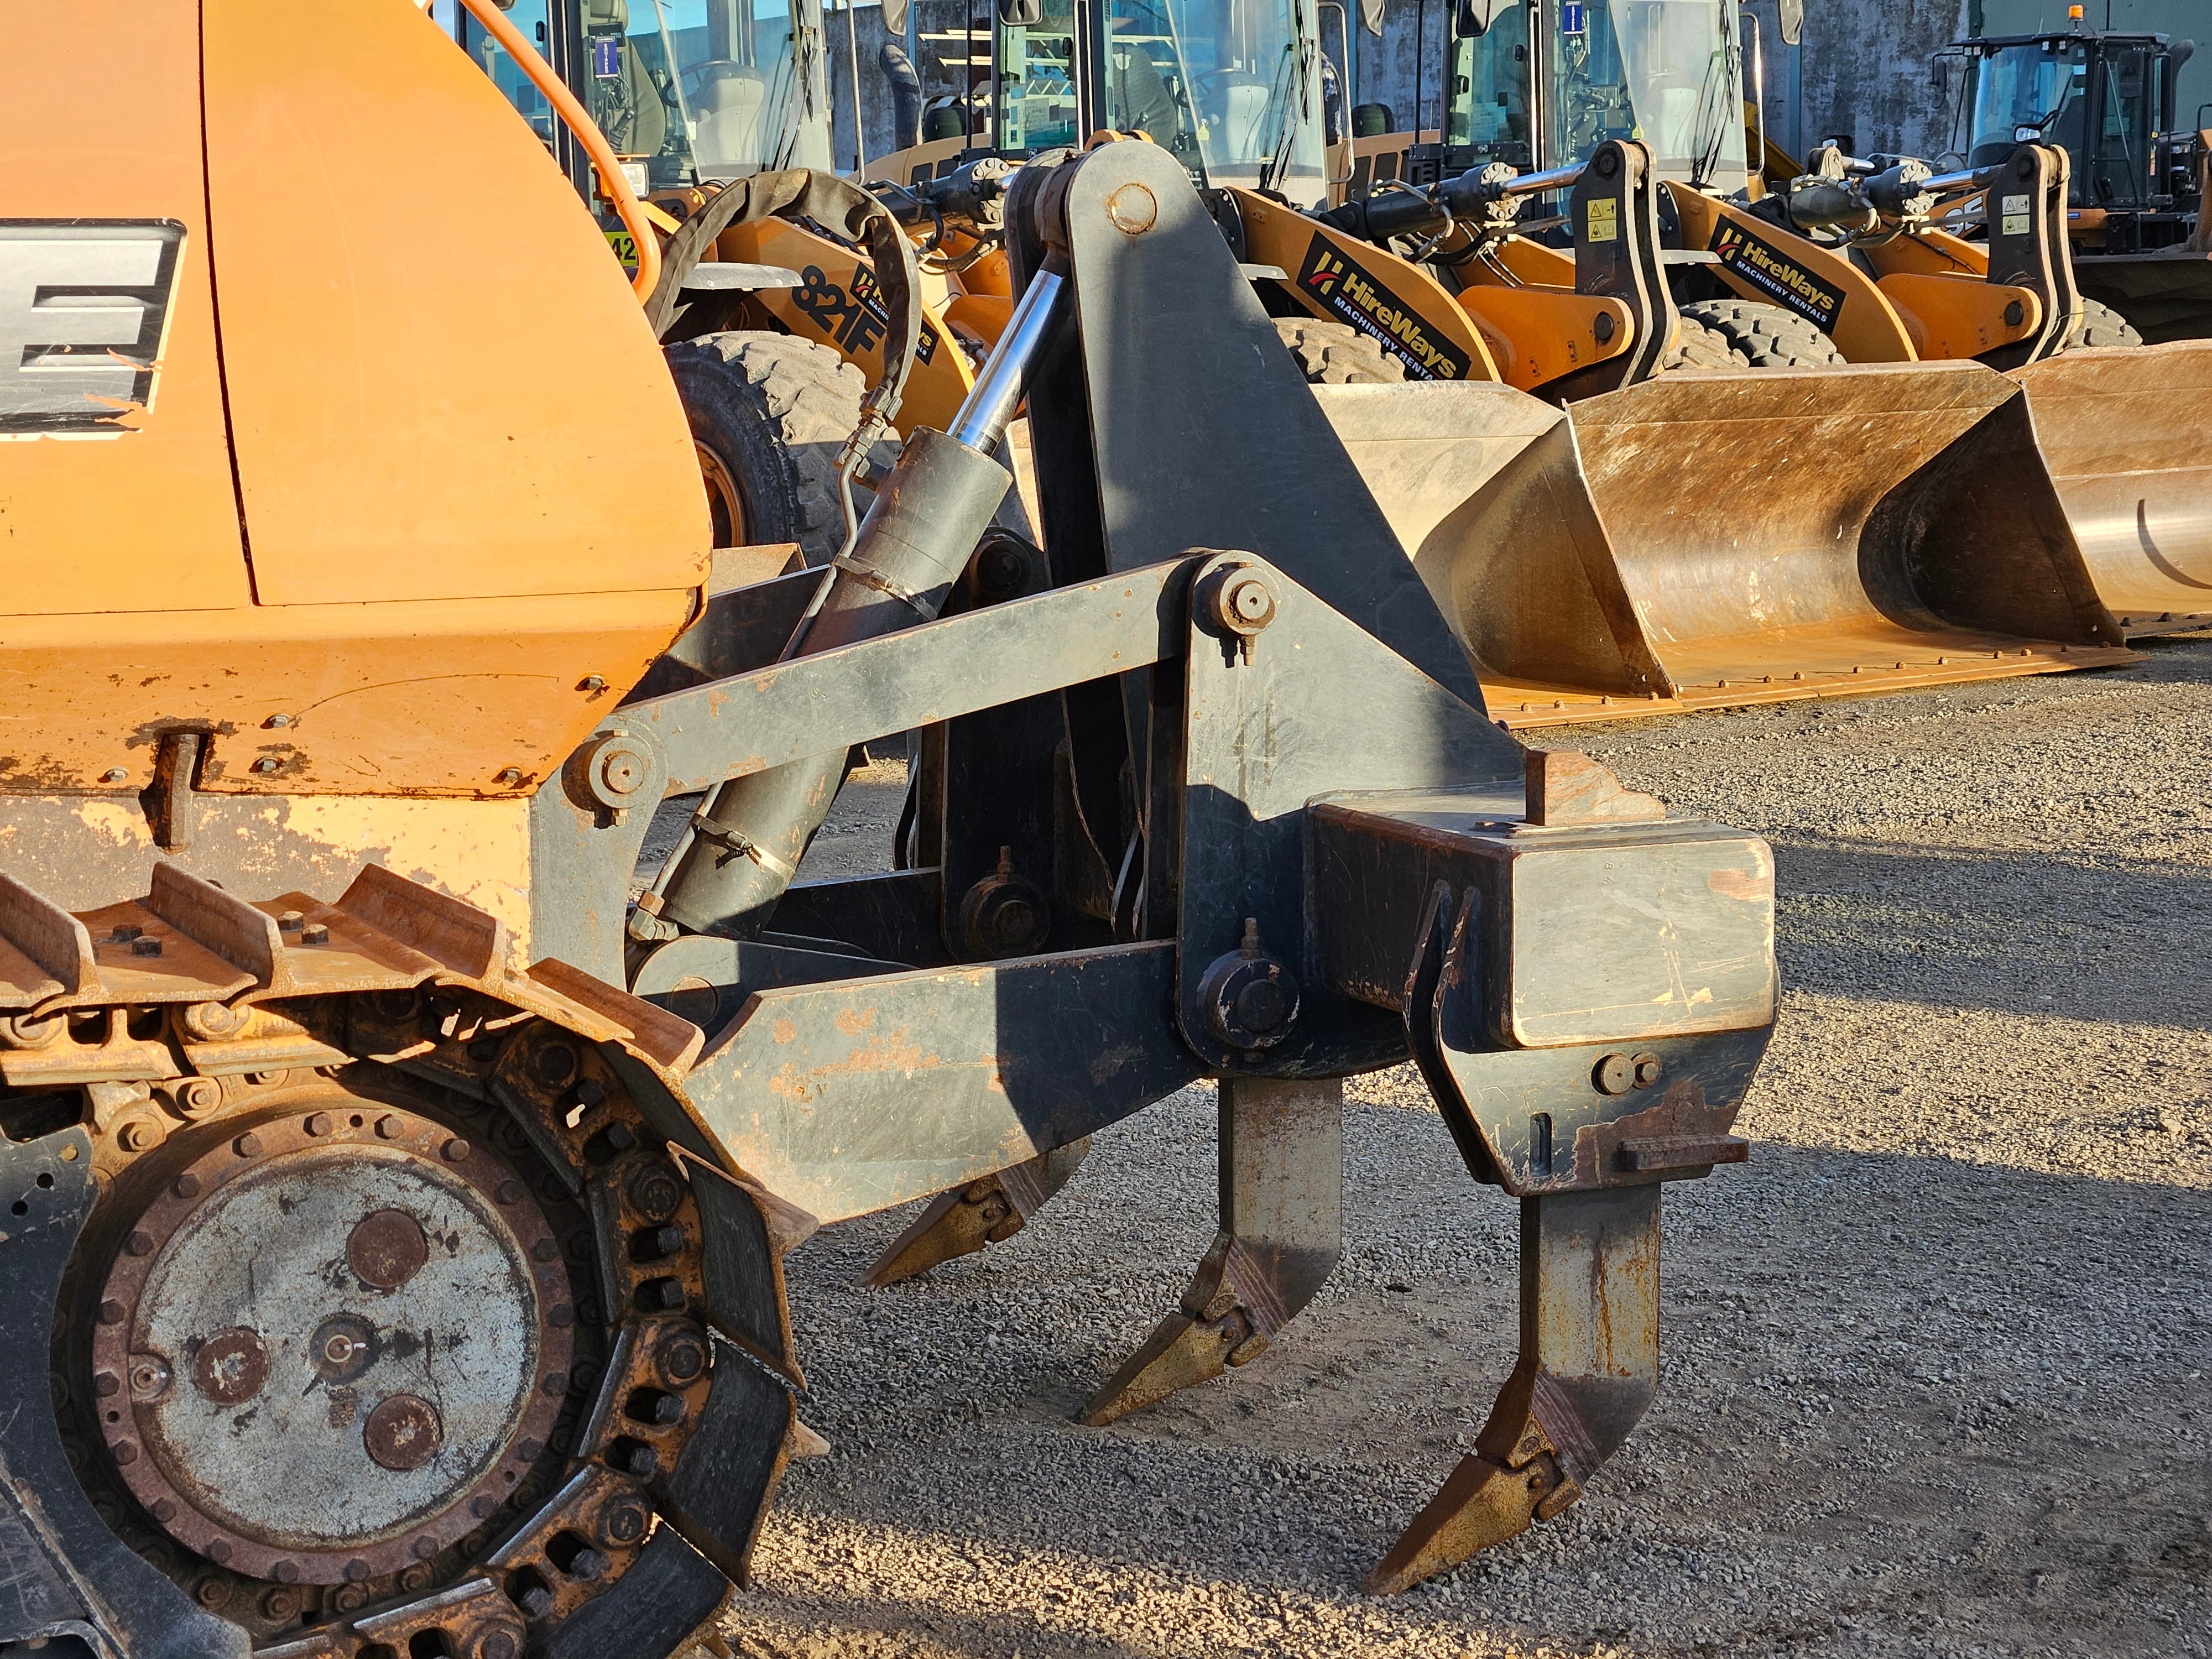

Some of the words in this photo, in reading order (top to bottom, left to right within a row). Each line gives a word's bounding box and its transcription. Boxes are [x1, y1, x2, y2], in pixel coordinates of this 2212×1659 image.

[791, 264, 886, 356] 821F
[868, 298, 890, 321] MACHI
[1736, 260, 1789, 296] MACHINERY
[1788, 294, 1828, 323] RENTALS
[1742, 241, 1835, 310] HireWays
[1333, 296, 1400, 352] MACHINERY
[1399, 350, 1433, 381] RENTA
[1342, 272, 1457, 379] HireWays
